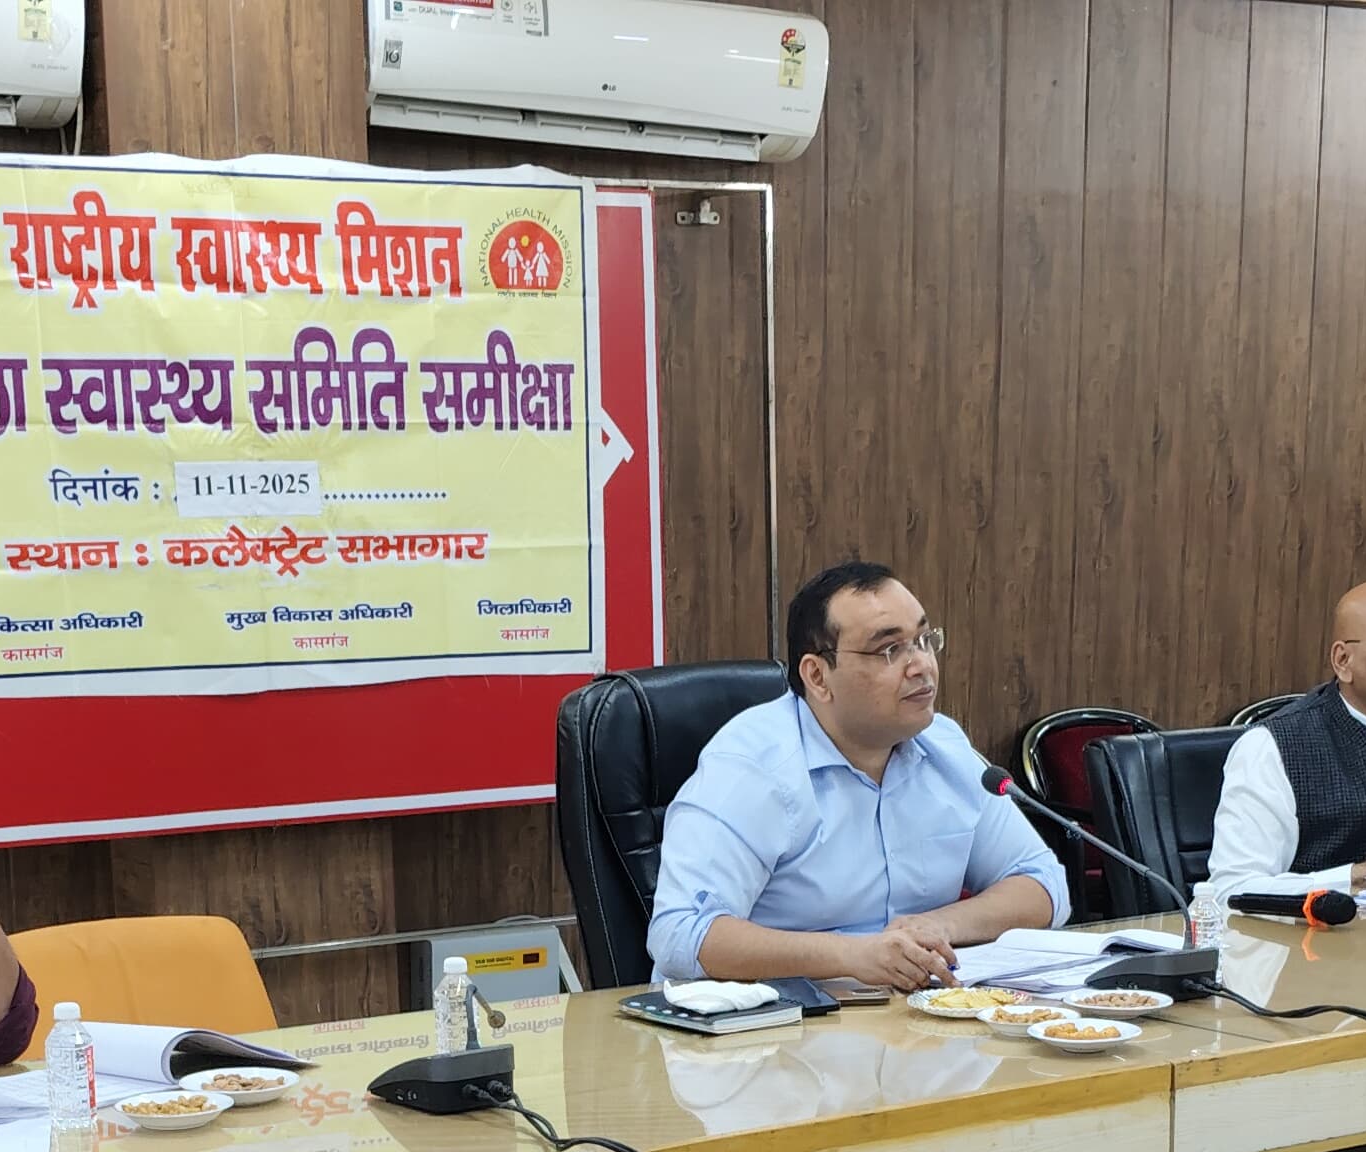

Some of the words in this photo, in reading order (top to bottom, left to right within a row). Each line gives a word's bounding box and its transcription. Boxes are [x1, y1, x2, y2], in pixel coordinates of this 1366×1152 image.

[3, 190, 158, 308] राष्ट्रीय
[171, 215, 323, 296] स्वास्थ्य
[334, 200, 464, 298] मिशन
[478, 218, 505, 287] NATIONAL
[505, 207, 551, 226] HEALTH
[551, 223, 573, 289] MISSION
[41, 358, 235, 434] स्वास्थ्य
[245, 326, 409, 435] समिति
[419, 329, 575, 434] समीक्षा
[48, 468, 140, 507] दिनांक
[191, 473, 311, 497] 11-11-2025
[4, 540, 120, 572] स्थान
[335, 532, 490, 564] सभागार
[272, 605, 334, 623] विकास
[338, 601, 414, 622] अधिकारी
[477, 597, 572, 617] जिलाधिकारी
[59, 610, 144, 632] अधिकारी
[292, 632, 350, 649] कासगंज
[499, 625, 550, 642] कासगंज
[0, 644, 64, 662] कासगंज
